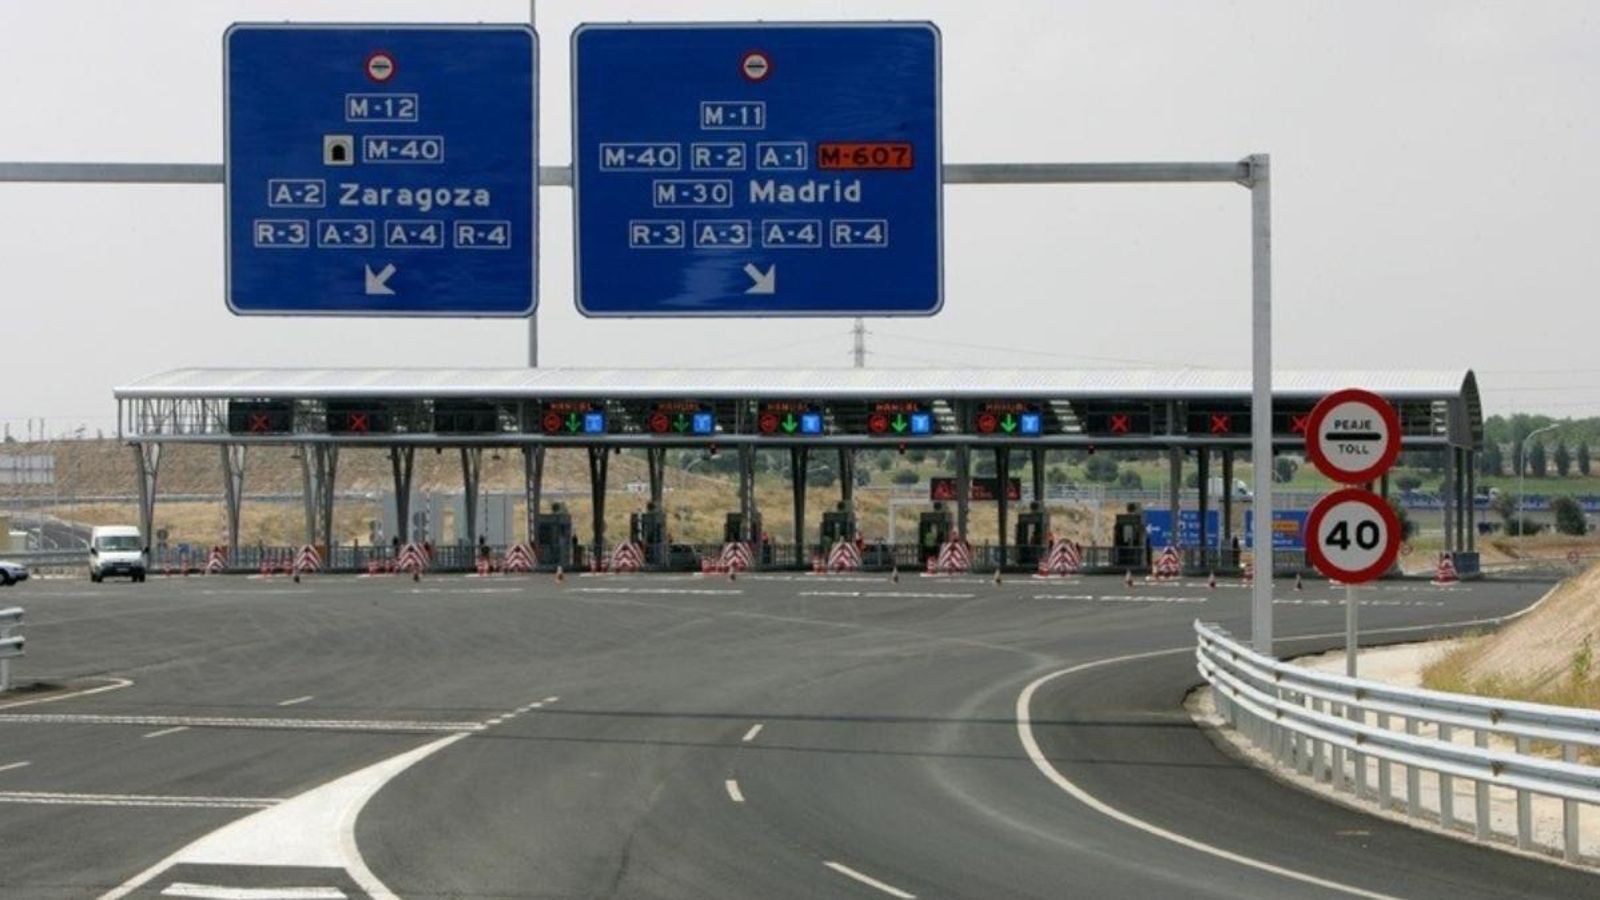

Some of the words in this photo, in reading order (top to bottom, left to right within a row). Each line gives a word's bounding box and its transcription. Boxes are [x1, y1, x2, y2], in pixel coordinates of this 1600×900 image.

[350, 98, 414, 118] M-12
[705, 106, 761, 125] M-11
[368, 140, 439, 159] M-40
[605, 147, 676, 167] M-40
[695, 147, 742, 167] R-2
[762, 147, 803, 167] A-1
[820, 147, 910, 167] M-607
[275, 183, 320, 203] A-2
[339, 183, 490, 212] Zaragoza
[657, 183, 728, 204] M-30
[749, 179, 861, 203] Madrid
[257, 224, 305, 244] R-3
[323, 224, 369, 244] A-3
[390, 224, 437, 244] A-4
[458, 225, 506, 245] R-4
[632, 224, 681, 245] R-3
[699, 224, 745, 245] A-3
[767, 224, 815, 244] A-4
[835, 224, 883, 244] R-4
[1334, 420, 1372, 430] PEAJE
[1338, 443, 1369, 455] TOLL
[1325, 519, 1380, 551] 40
